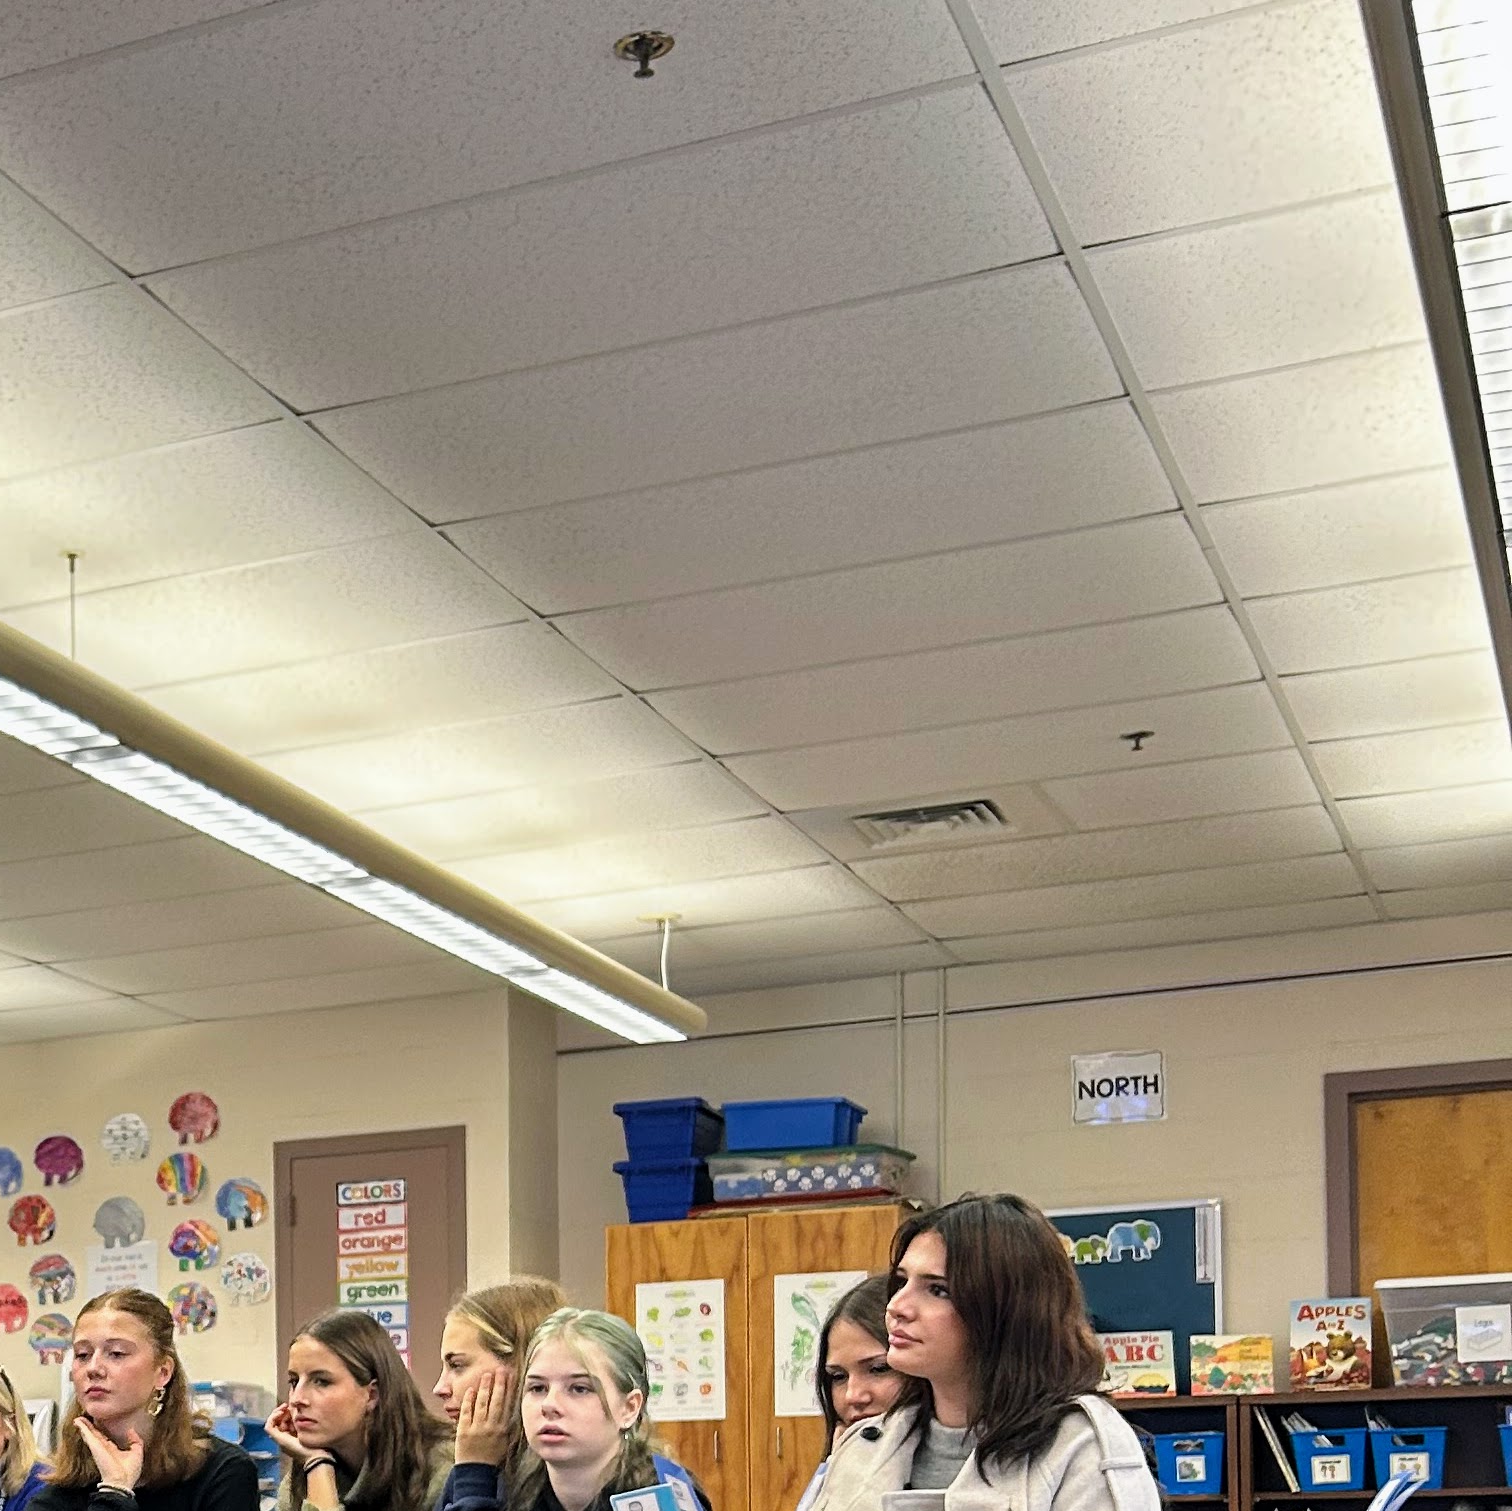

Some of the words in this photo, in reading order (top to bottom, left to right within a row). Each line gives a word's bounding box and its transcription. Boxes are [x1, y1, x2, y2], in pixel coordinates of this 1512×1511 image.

[1078, 1073, 1159, 1100] NORTH
[341, 1182, 402, 1201] COLORS
[354, 1208, 386, 1226] red
[341, 1233, 404, 1252] orange
[346, 1259, 399, 1279] yellow
[346, 1283, 400, 1304] green
[1297, 1304, 1367, 1322] APPLES
[1316, 1319, 1327, 1332] A
[1103, 1335, 1138, 1346] Apple
[1140, 1334, 1160, 1343] Pie
[1104, 1343, 1166, 1363] ABC
